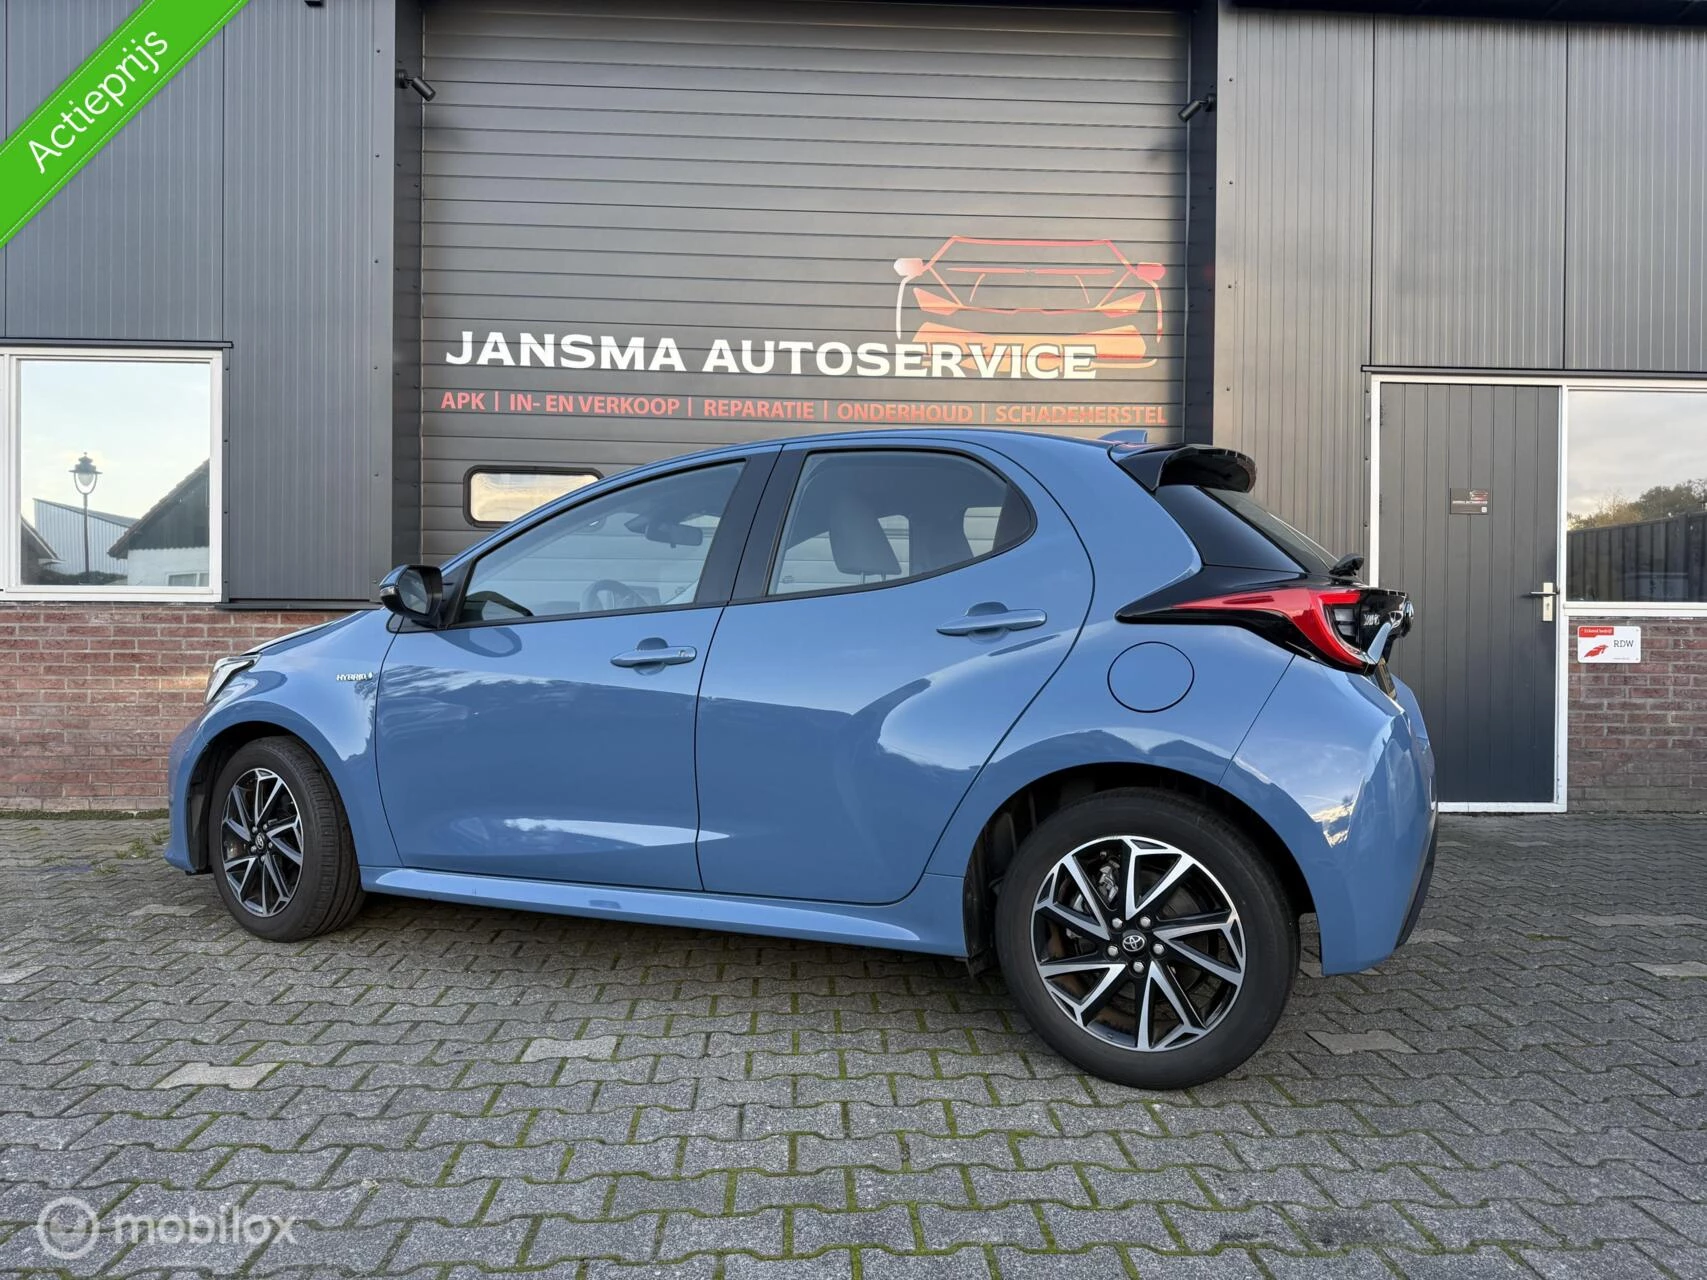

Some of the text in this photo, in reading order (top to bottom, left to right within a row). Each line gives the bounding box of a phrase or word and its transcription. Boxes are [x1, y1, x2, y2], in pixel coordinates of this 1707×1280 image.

[445, 331, 1096, 379] JANSMA AUTOSERVICE
[440, 391, 1167, 424] APK IN- EN VERKOOP REPARATIE ONDERHOUD SCHADEHERSTEL
[1613, 639, 1634, 648] RDW
